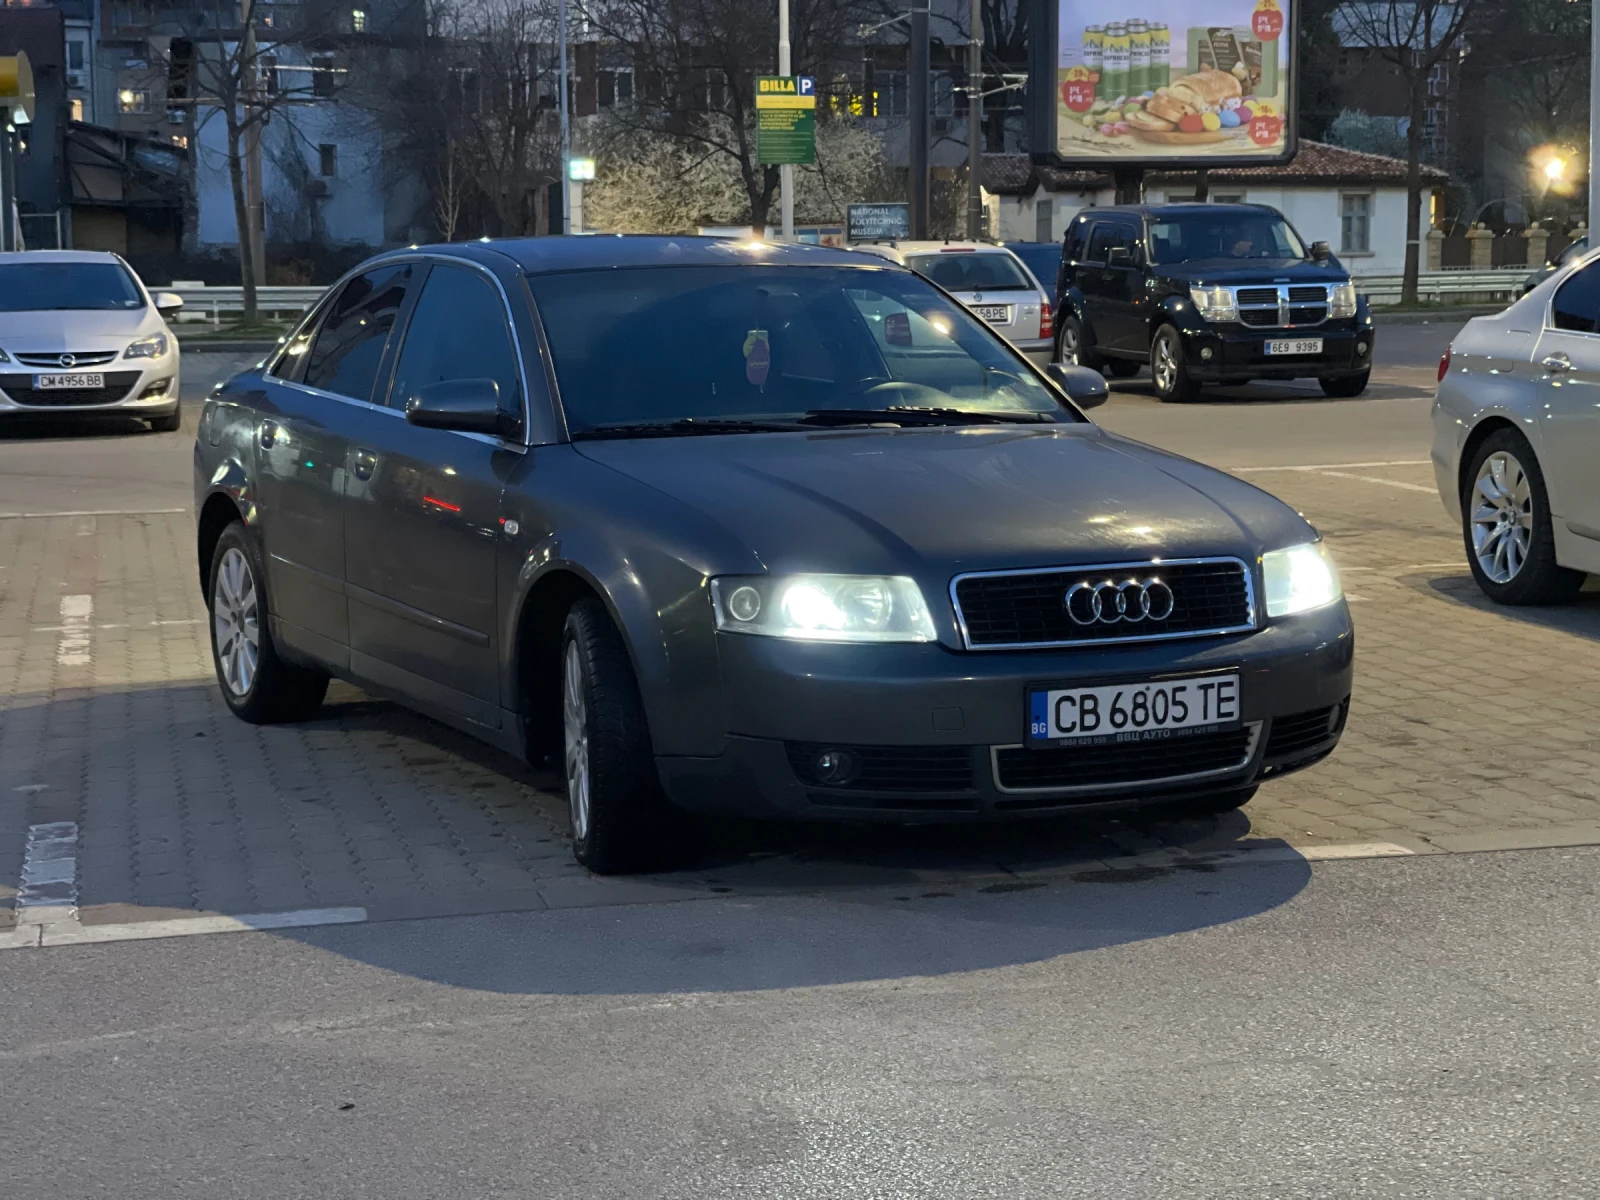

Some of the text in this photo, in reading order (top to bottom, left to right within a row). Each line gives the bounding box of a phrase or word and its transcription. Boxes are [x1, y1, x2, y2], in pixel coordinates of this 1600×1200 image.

[760, 80, 795, 92] BILLA
[802, 79, 812, 94] P
[992, 308, 1005, 318] PE
[1272, 341, 1318, 352] 6E9 9395
[40, 376, 56, 387] CM
[57, 375, 85, 386] 4956
[86, 375, 101, 386] BB
[1055, 681, 1235, 733] CB 6805 TE
[1031, 723, 1046, 735] BG
